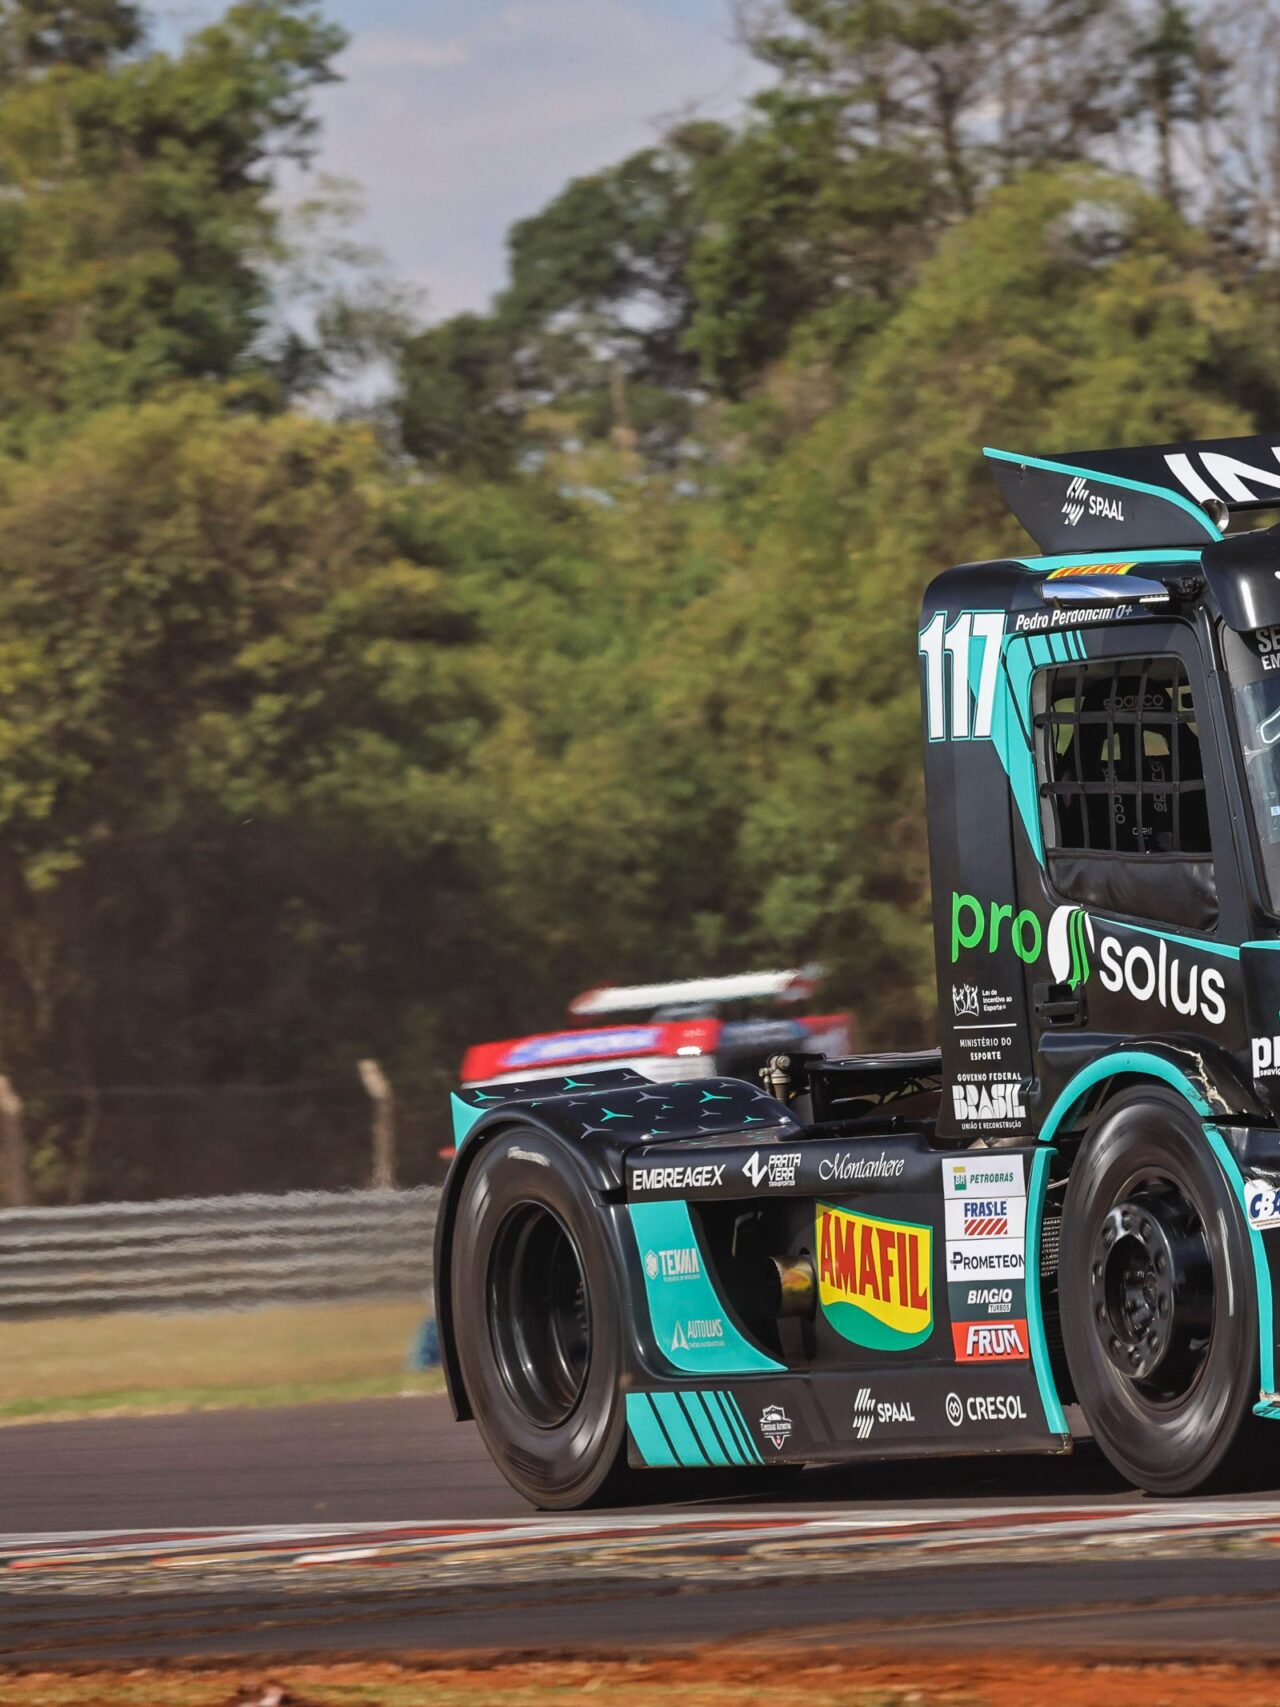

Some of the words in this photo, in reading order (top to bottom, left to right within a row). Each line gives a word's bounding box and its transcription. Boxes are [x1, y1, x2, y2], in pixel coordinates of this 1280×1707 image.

[1088, 494, 1124, 522] SPAAL
[1015, 612, 1049, 631] Pedro
[1051, 605, 1115, 627] Perdoncini
[918, 609, 1008, 743] 117
[951, 891, 1042, 964] pro
[1098, 936, 1227, 1025] solus
[959, 1036, 999, 1048] MINISTÉRIO
[1001, 1037, 1012, 1046] DO
[970, 1051, 1002, 1061] ESPORTE
[957, 1072, 987, 1082] GOVERNO
[988, 1072, 1022, 1081] FEDERAL
[951, 1083, 1027, 1121] BRASIL
[768, 1152, 802, 1168] PRATA
[818, 1150, 905, 1182] Montanhere
[632, 1163, 726, 1191] EMBREAGEX
[768, 1166, 795, 1182] VERA
[969, 1172, 1014, 1184] PETROBRAS
[820, 1211, 928, 1311] AMAFIL
[950, 1250, 1025, 1272] PROMETEON
[967, 1288, 1013, 1305] BIAGIO
[989, 1304, 1010, 1312] TURBOS
[966, 1323, 1025, 1356] FRUM
[877, 1402, 915, 1424] SPAAL
[966, 1396, 1027, 1421] CRESOL
